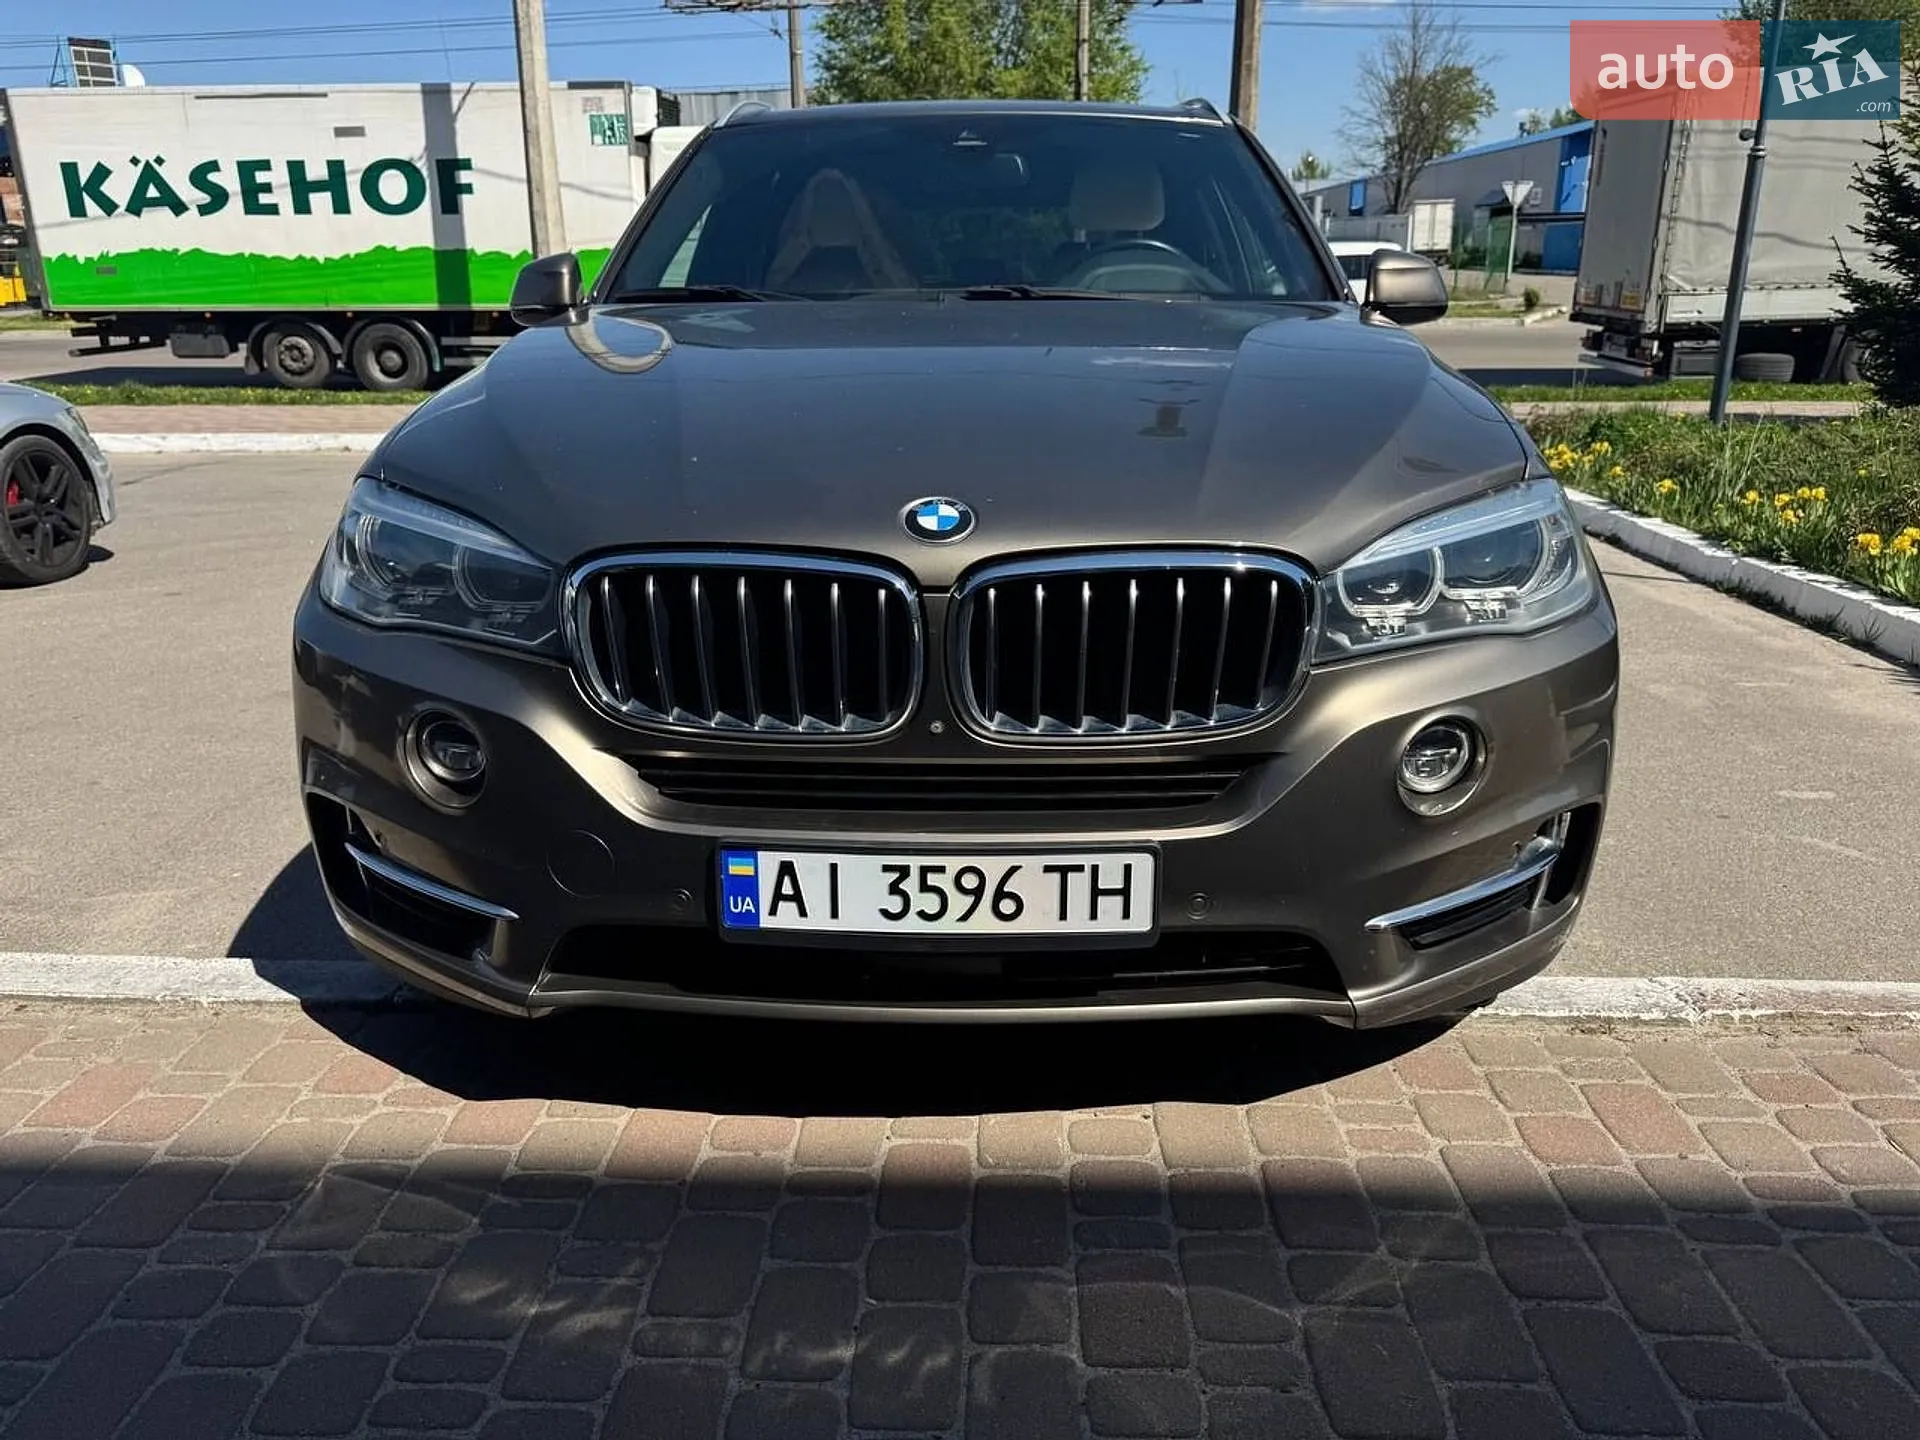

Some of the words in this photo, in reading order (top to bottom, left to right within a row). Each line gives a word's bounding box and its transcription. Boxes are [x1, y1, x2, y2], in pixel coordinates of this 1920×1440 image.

[59, 154, 474, 219] KÄSEHOF
[729, 895, 756, 914] UA
[768, 859, 839, 920] AI
[878, 863, 1025, 923] 3596
[1043, 862, 1133, 921] TH
